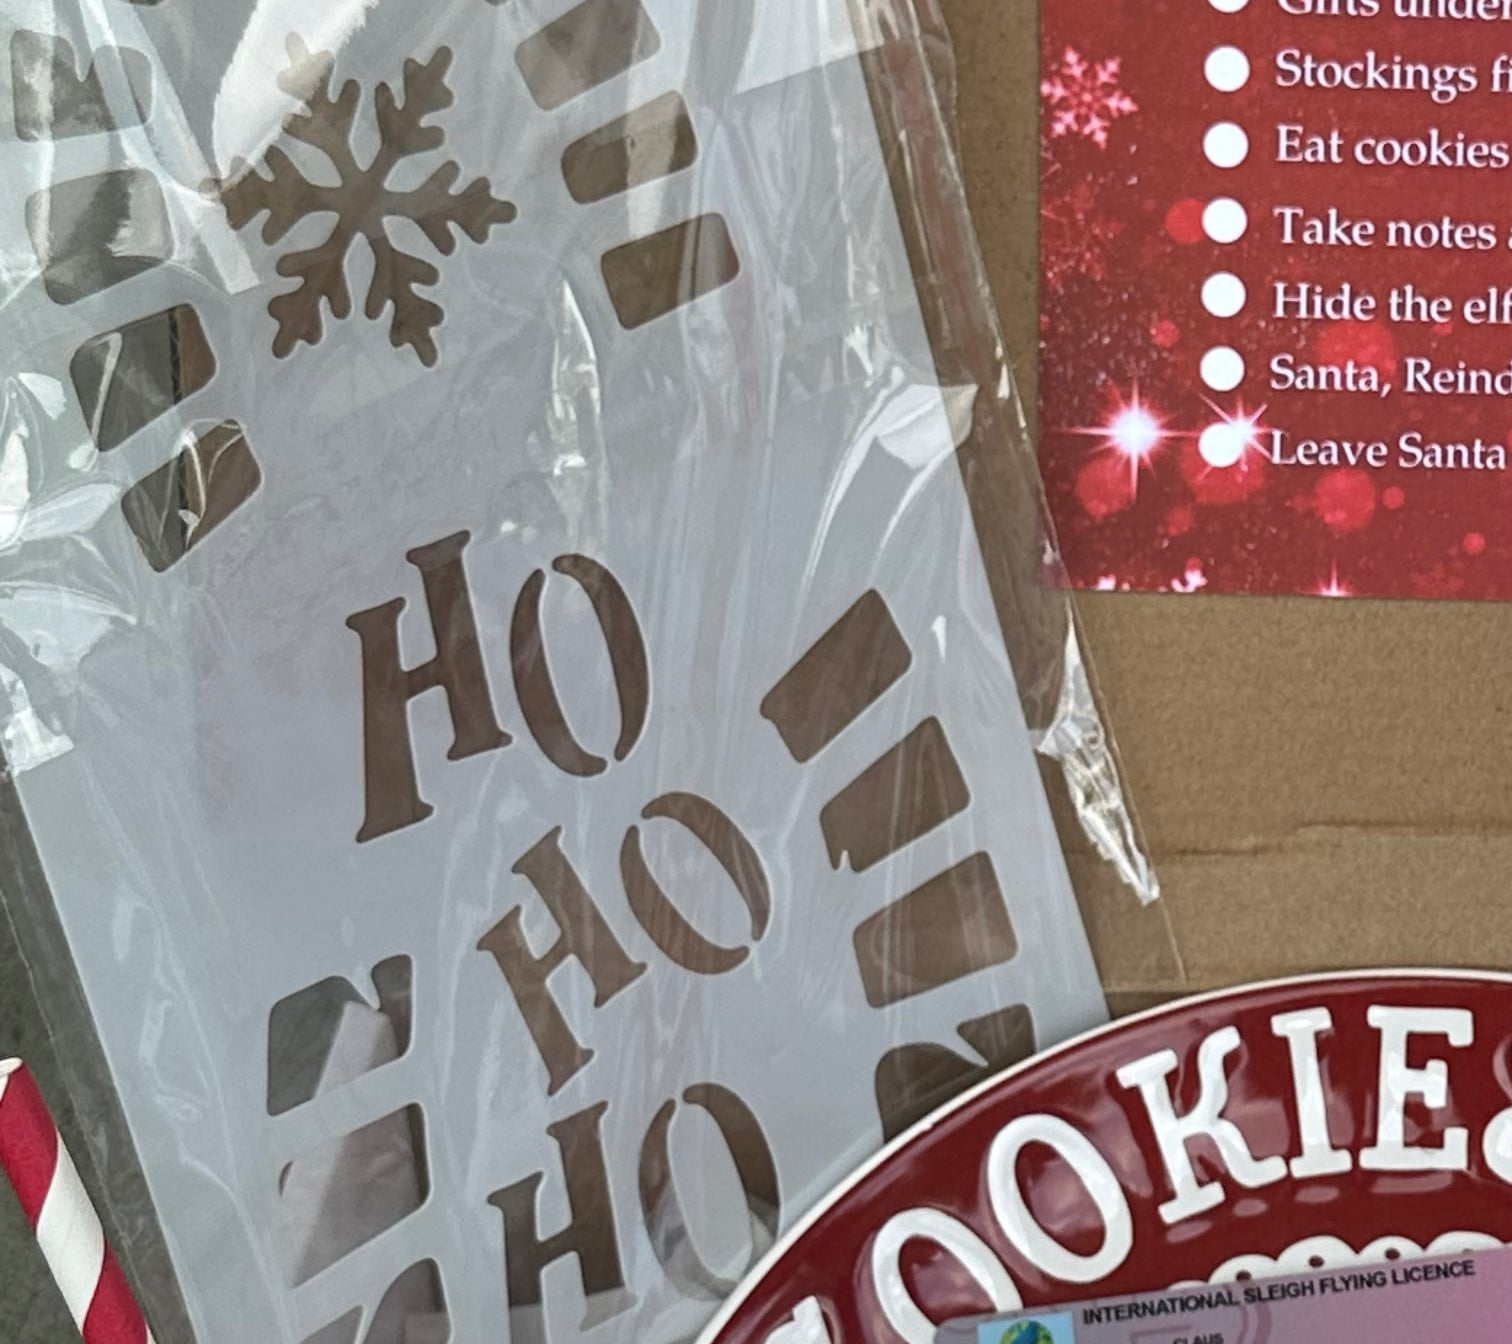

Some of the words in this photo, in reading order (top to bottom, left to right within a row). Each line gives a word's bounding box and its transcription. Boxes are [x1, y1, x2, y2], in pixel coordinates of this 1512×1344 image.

[1275, 48, 1478, 104] Stockings
[1275, 124, 1344, 163] Eat
[1354, 128, 1510, 168] cookies
[1272, 207, 1376, 246] Take
[1386, 215, 1497, 249] notes
[1273, 281, 1376, 321] Hide
[1389, 284, 1452, 323] the
[1270, 354, 1392, 398] Santa,
[1270, 429, 1389, 467] Leave
[1398, 431, 1506, 470] Santa
[344, 529, 652, 844] HO
[476, 791, 773, 1097] HO
[1083, 1290, 1240, 1324] INTERNATIONAL
[1243, 1281, 1316, 1305] SLEIGH
[1319, 1270, 1387, 1294] FLYING
[1391, 1260, 1476, 1286] LICENCE
